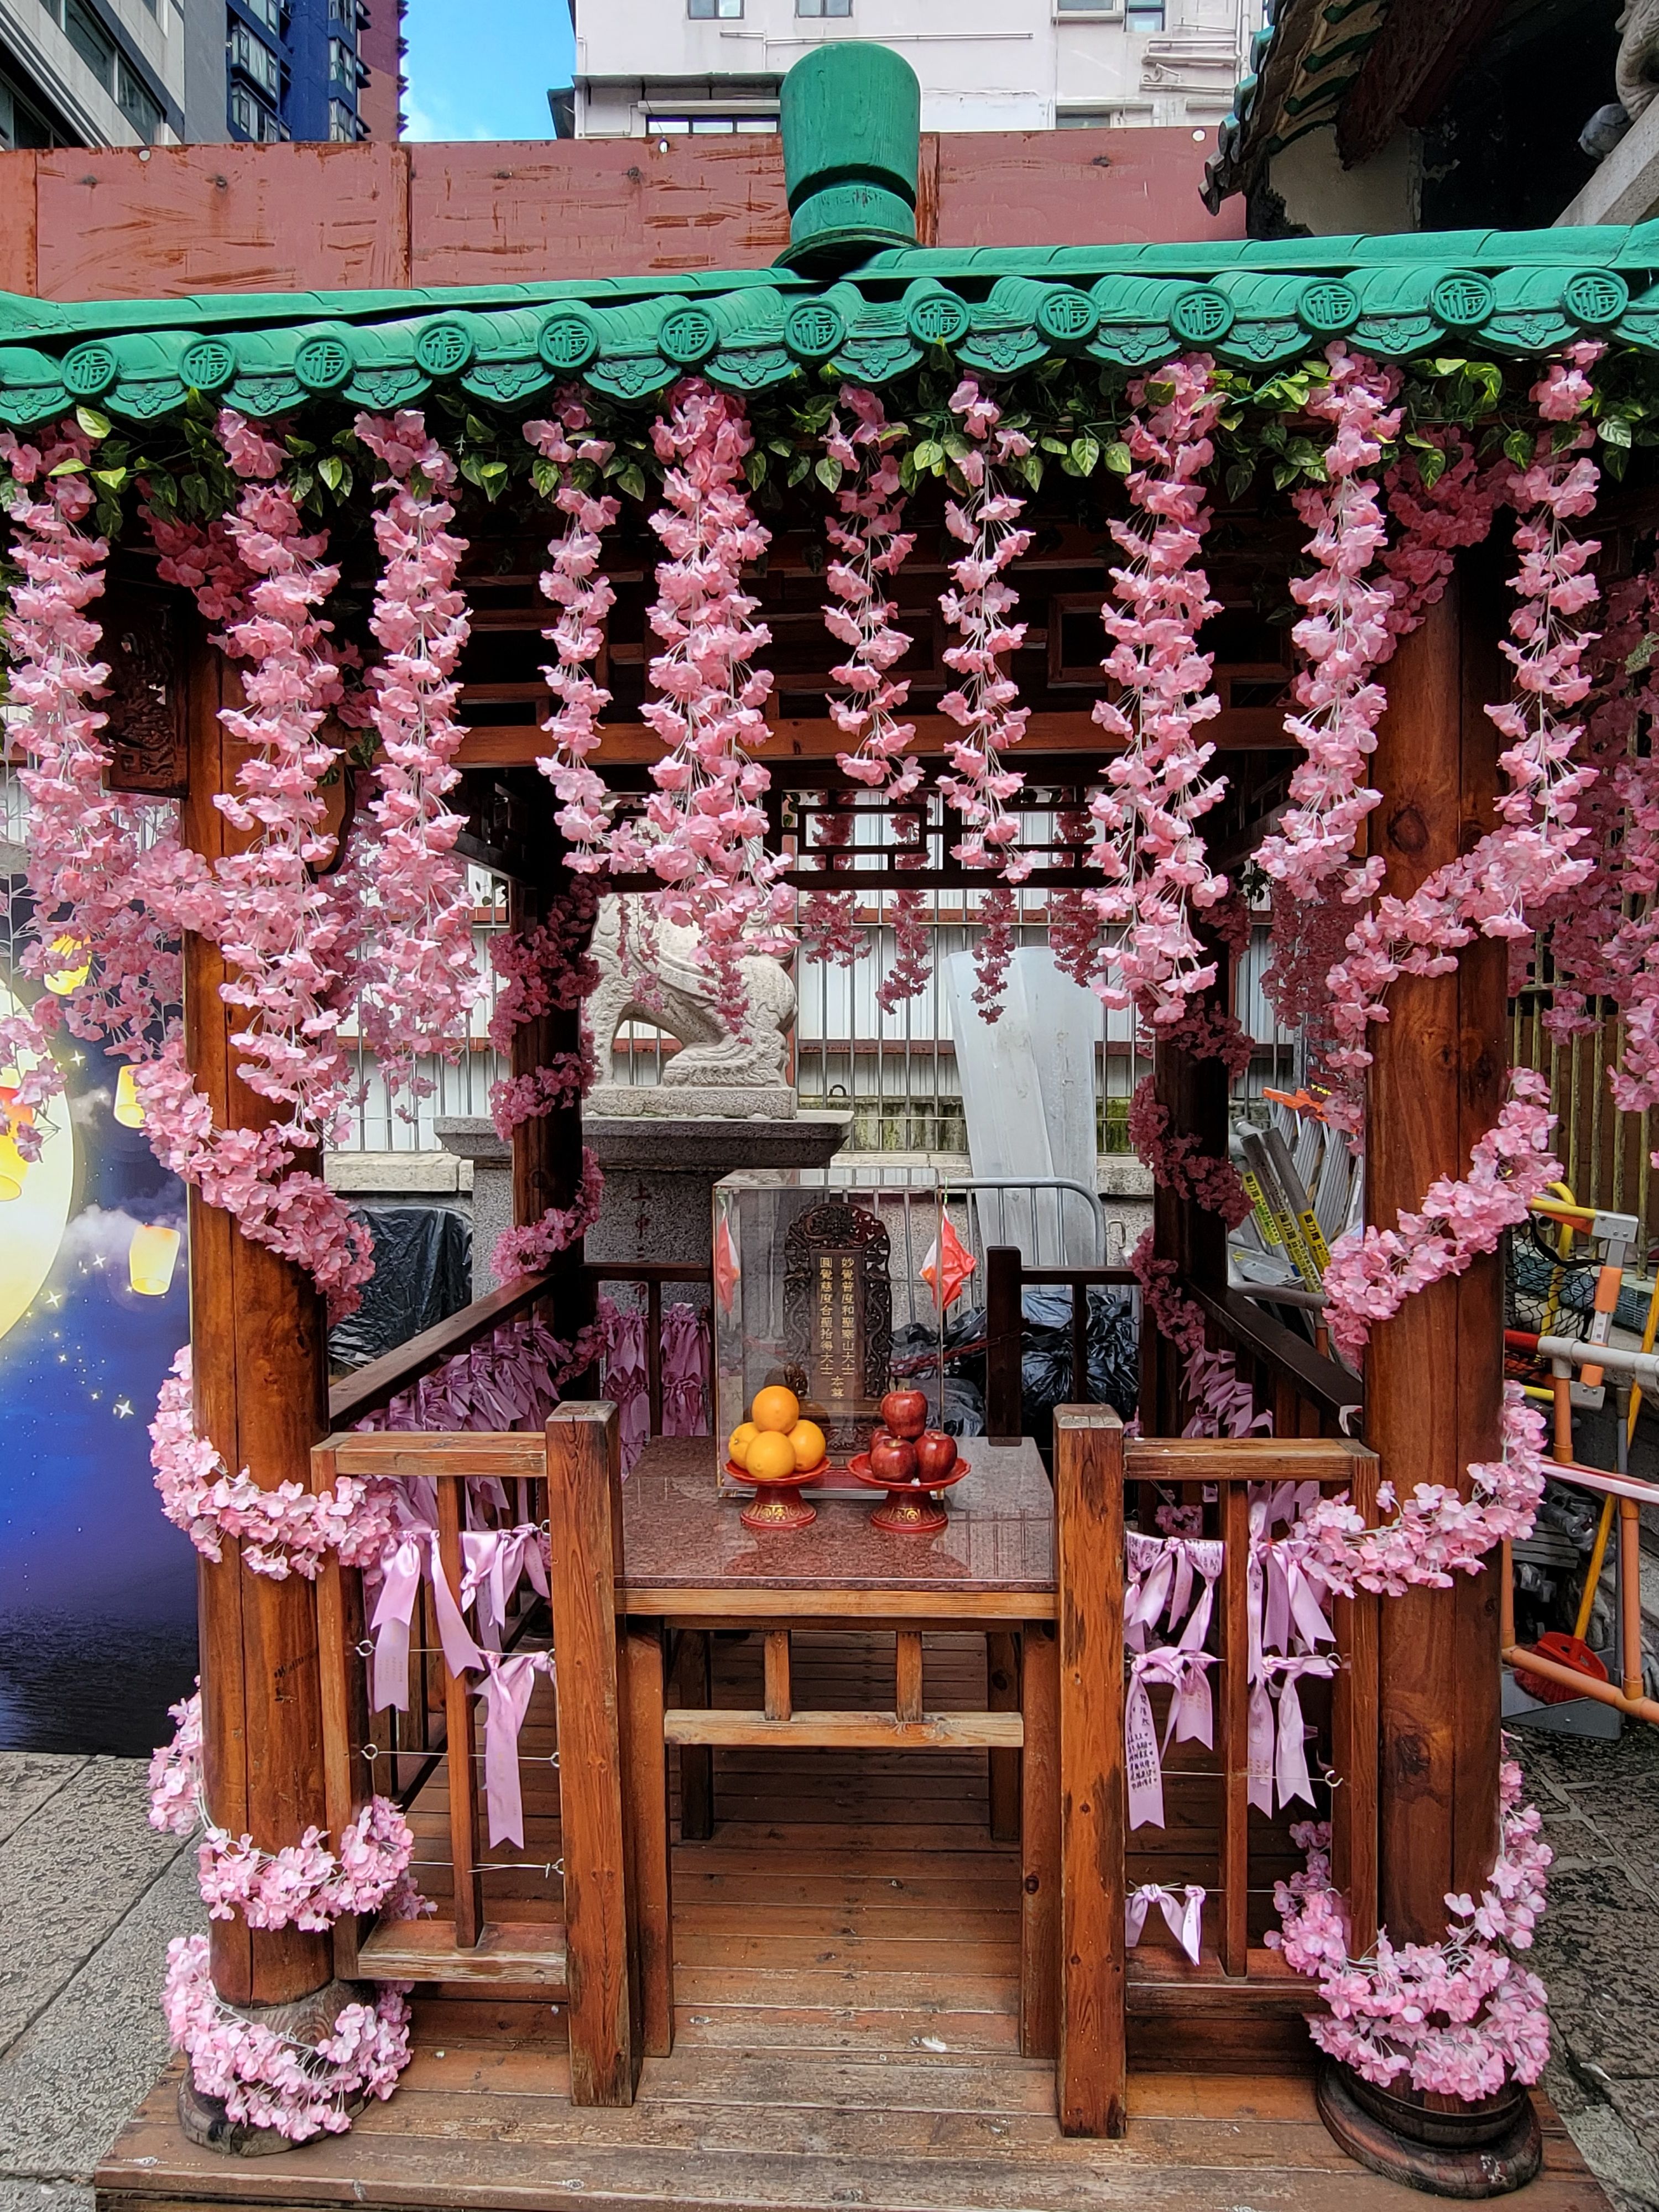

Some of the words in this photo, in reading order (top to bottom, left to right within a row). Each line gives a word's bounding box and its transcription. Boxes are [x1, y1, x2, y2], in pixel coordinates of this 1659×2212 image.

[1047, 296, 1092, 334] 福
[1179, 296, 1225, 336] 福
[1305, 287, 1353, 325] 福
[1438, 281, 1488, 320] 福
[1572, 280, 1619, 319] 福
[665, 316, 711, 355] 福
[792, 310, 838, 350] 福
[916, 302, 961, 340] 福
[421, 330, 466, 368] 福
[545, 324, 591, 362] 福
[70, 351, 111, 389] 福
[185, 347, 229, 385] 福
[301, 344, 346, 383] 福
